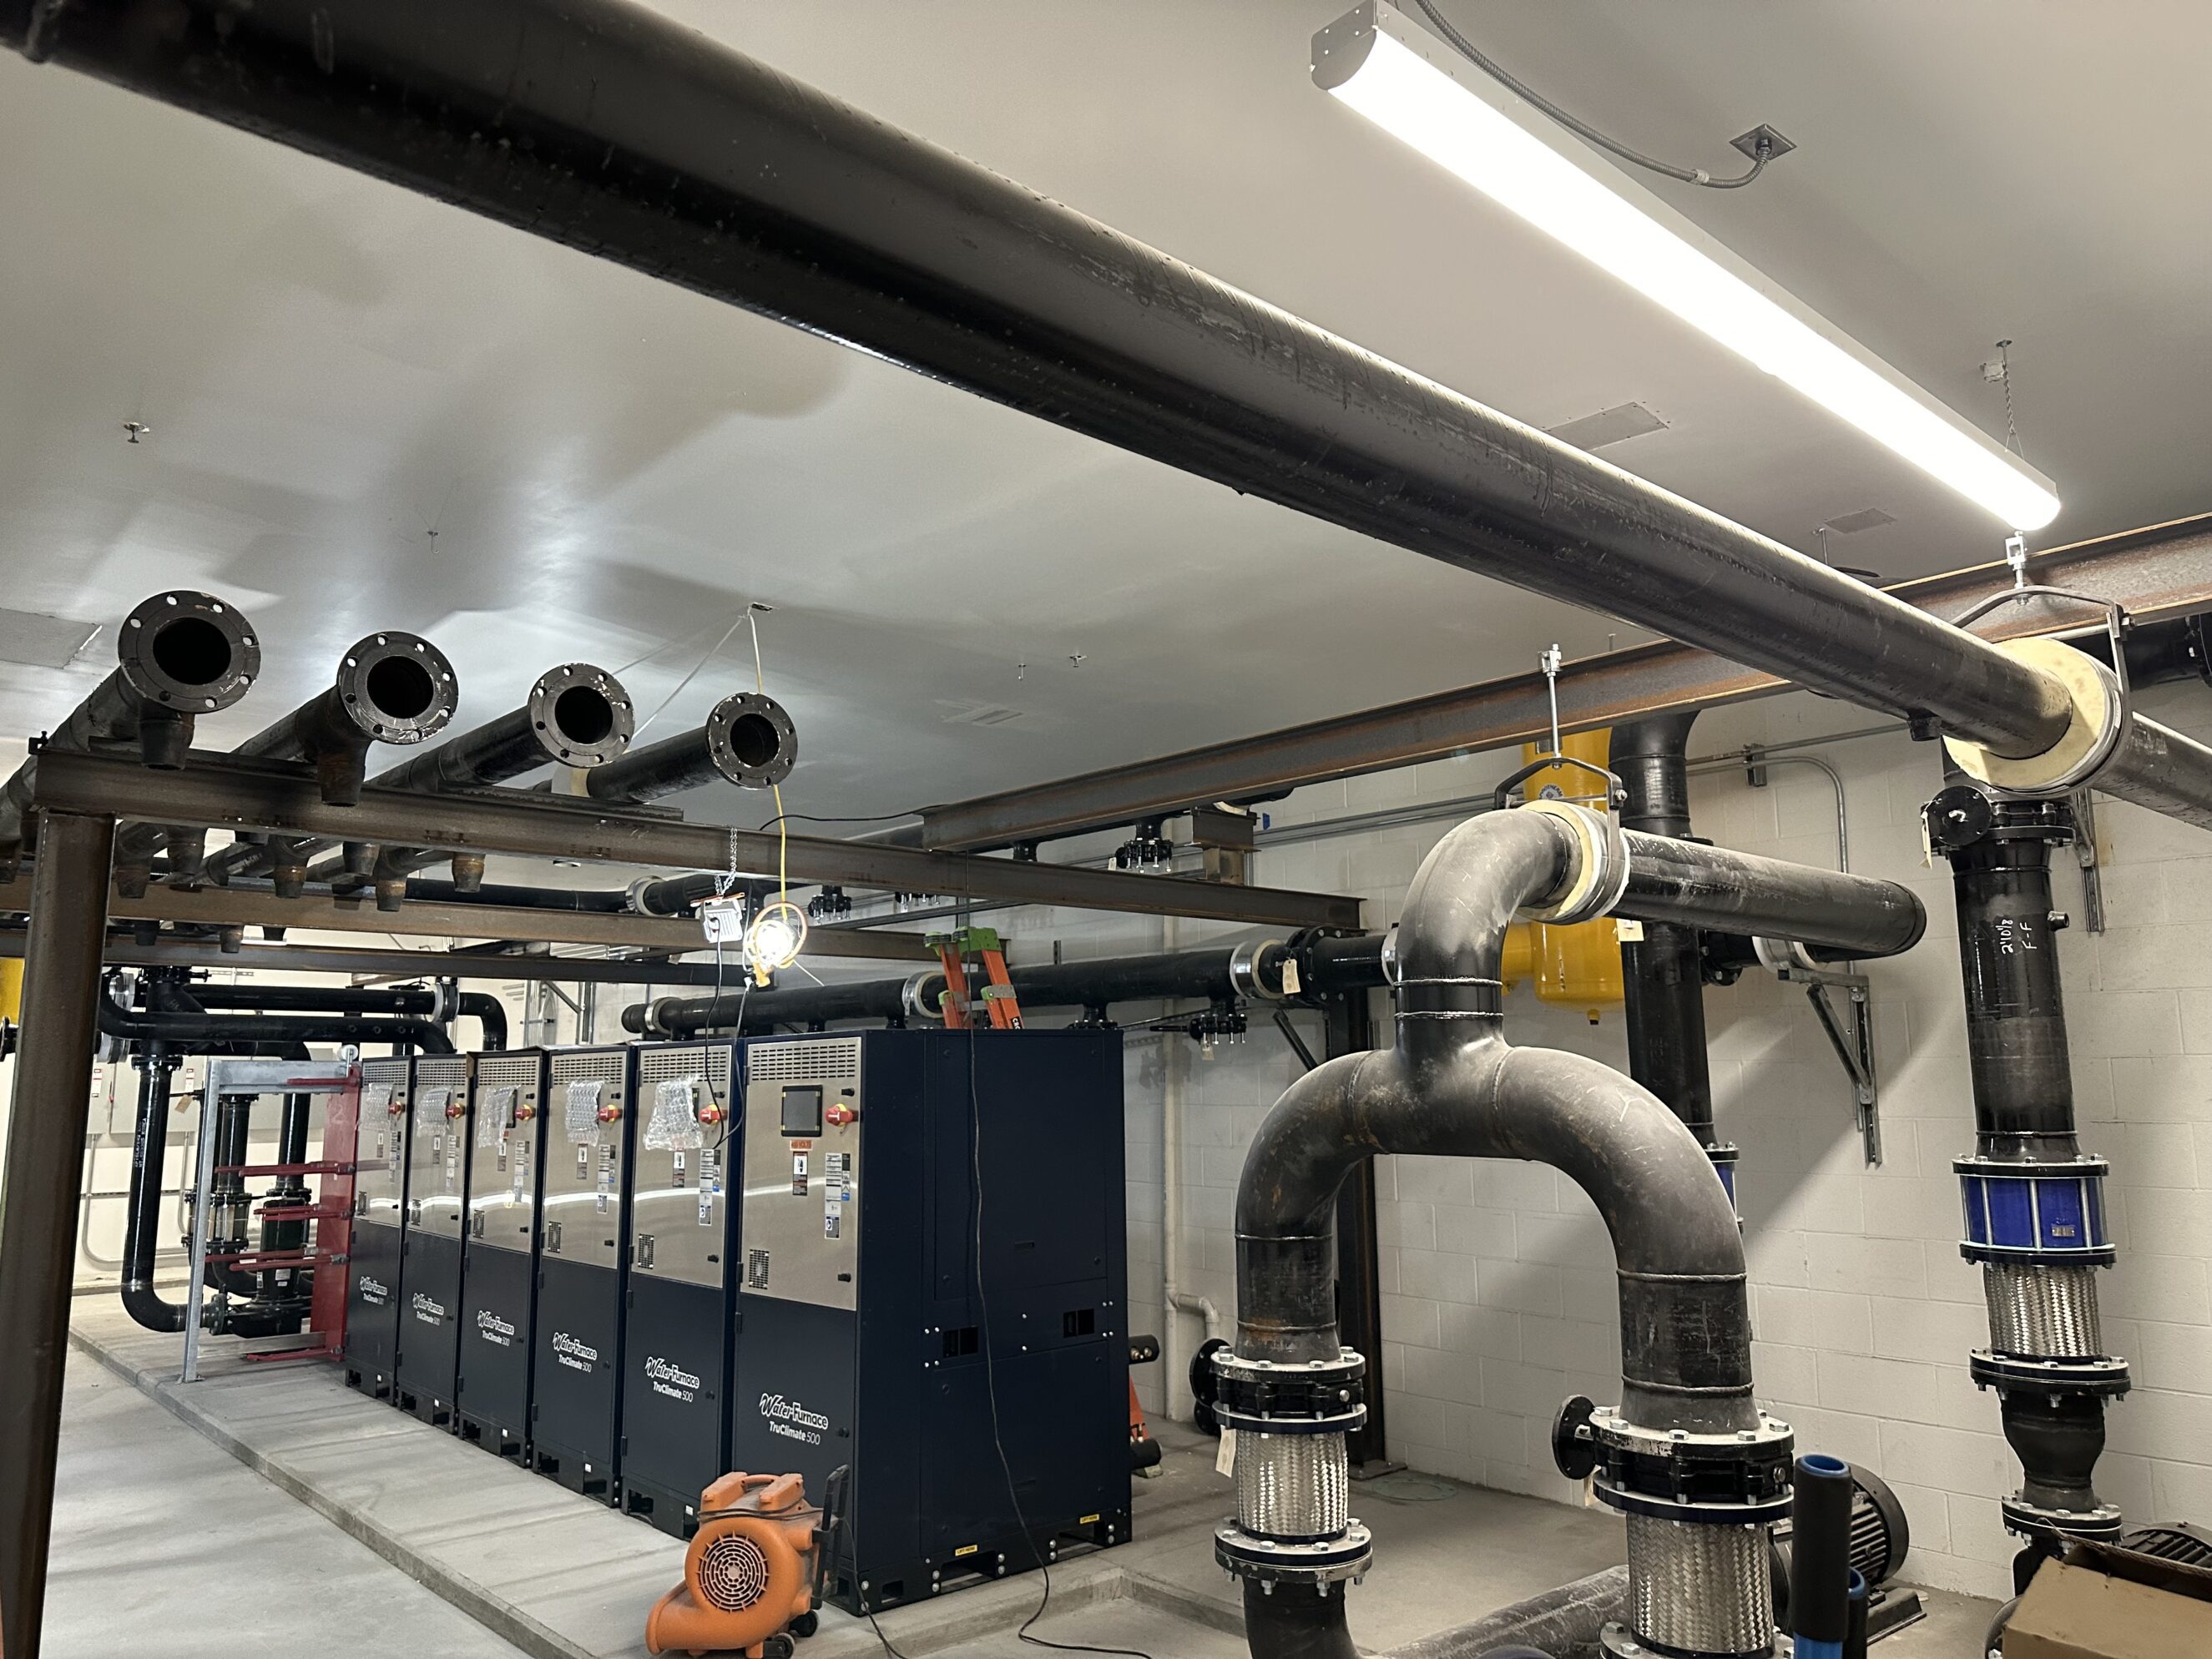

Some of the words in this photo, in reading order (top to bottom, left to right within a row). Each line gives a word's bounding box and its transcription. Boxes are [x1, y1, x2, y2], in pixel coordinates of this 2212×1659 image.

[552, 1332, 598, 1361] WaterFurnace
[558, 1354, 582, 1370] TruClimate
[644, 1356, 699, 1389] WaterFurnace
[653, 1380, 682, 1399] TruClimate
[682, 1390, 694, 1403] 500
[759, 1393, 829, 1430] WaterFurnace
[769, 1420, 806, 1441] TruClimate
[806, 1431, 821, 1445] 500
